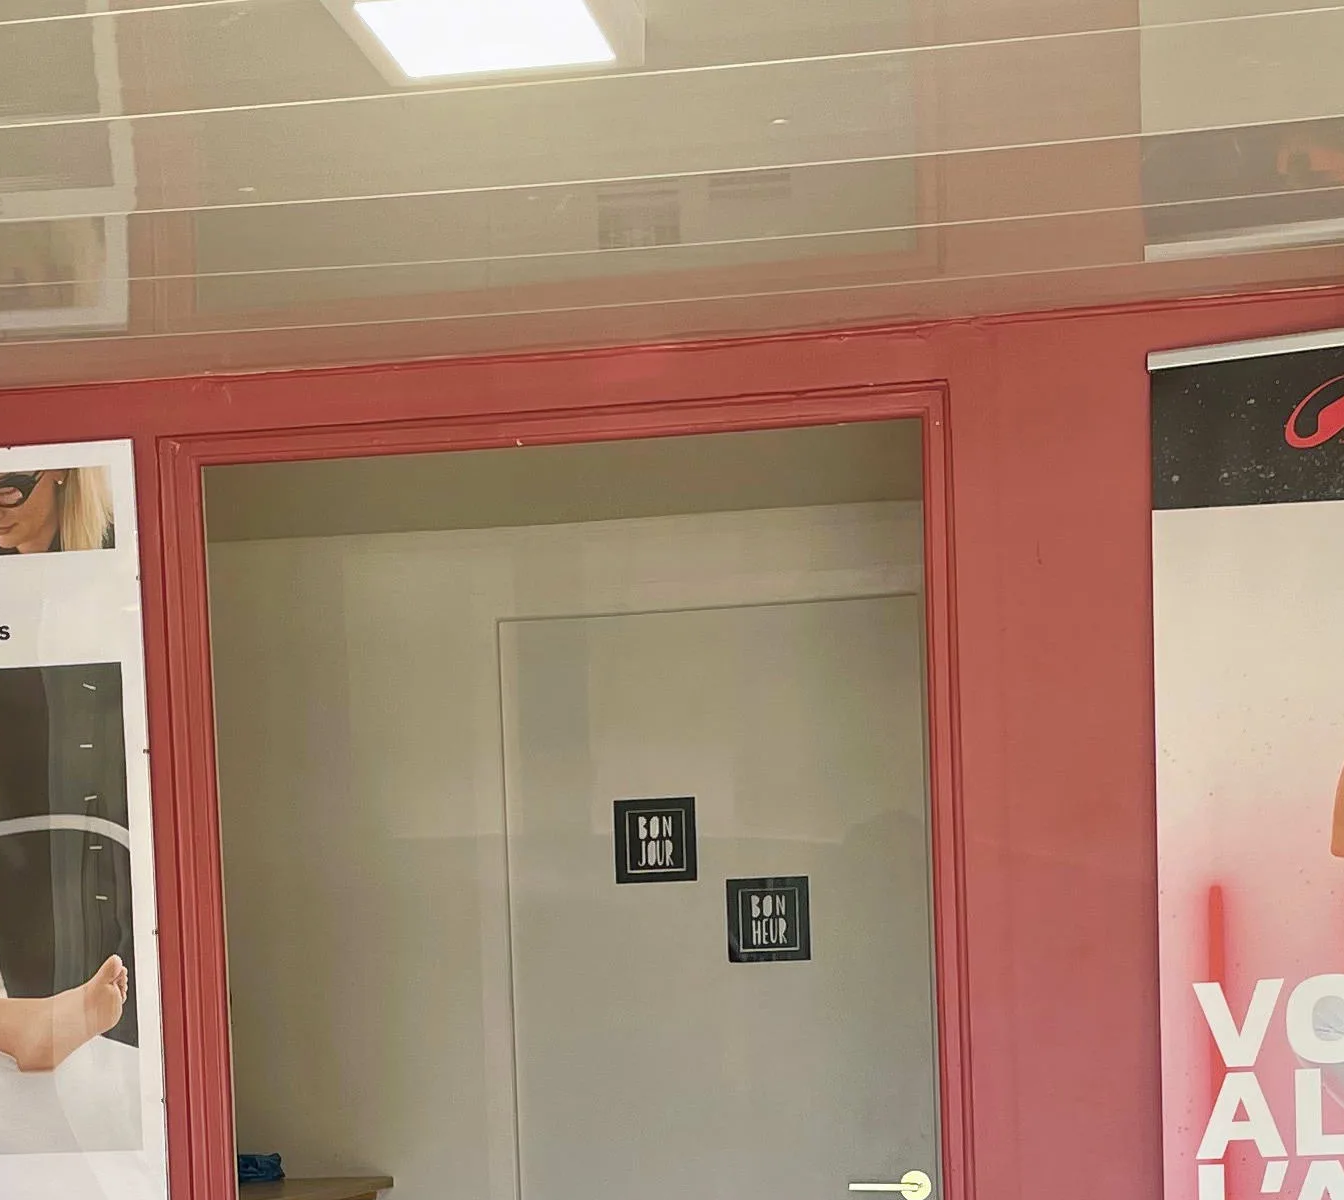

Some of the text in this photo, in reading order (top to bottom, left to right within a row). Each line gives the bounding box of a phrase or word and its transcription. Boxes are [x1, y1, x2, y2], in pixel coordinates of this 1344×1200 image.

[637, 814, 673, 840] BON
[637, 839, 674, 867] JOUR
[750, 893, 786, 918] BON
[751, 916, 788, 946] HEUR
